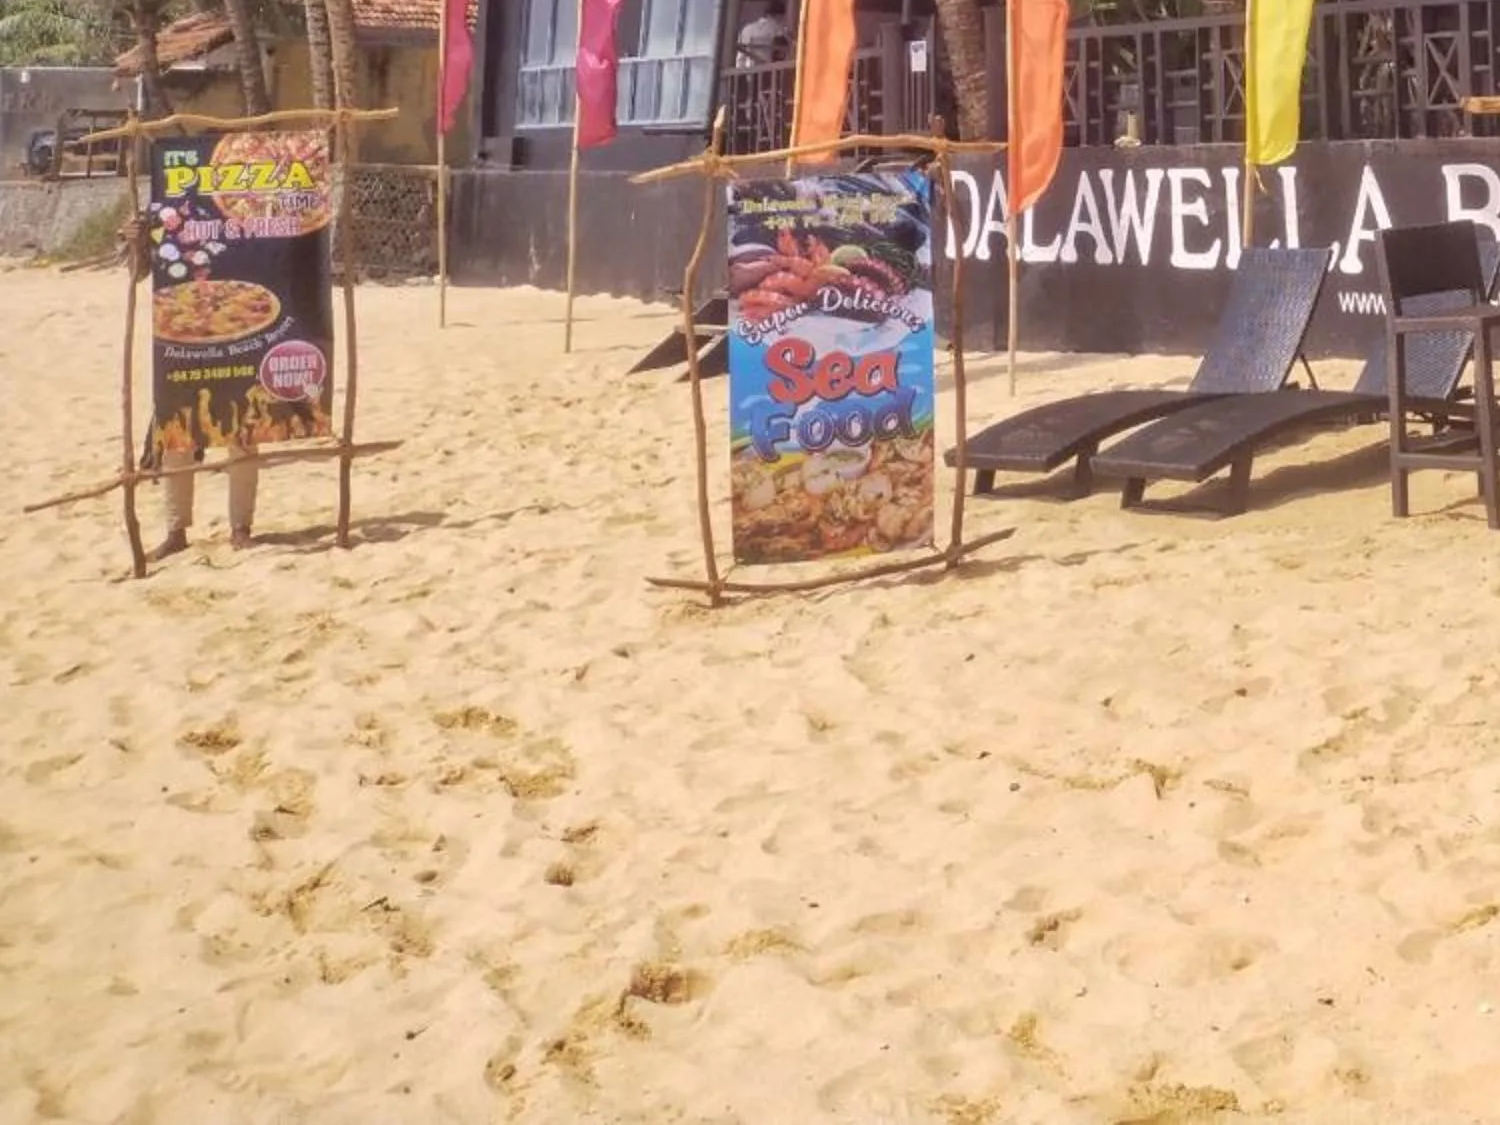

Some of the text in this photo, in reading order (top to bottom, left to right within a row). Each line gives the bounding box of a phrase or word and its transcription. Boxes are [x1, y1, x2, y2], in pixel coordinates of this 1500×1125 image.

[163, 150, 199, 166] IT'S
[163, 160, 318, 198] PIZZA
[736, 285, 926, 345] Super Delicious
[764, 337, 902, 406] Sea
[749, 385, 917, 462] Food
